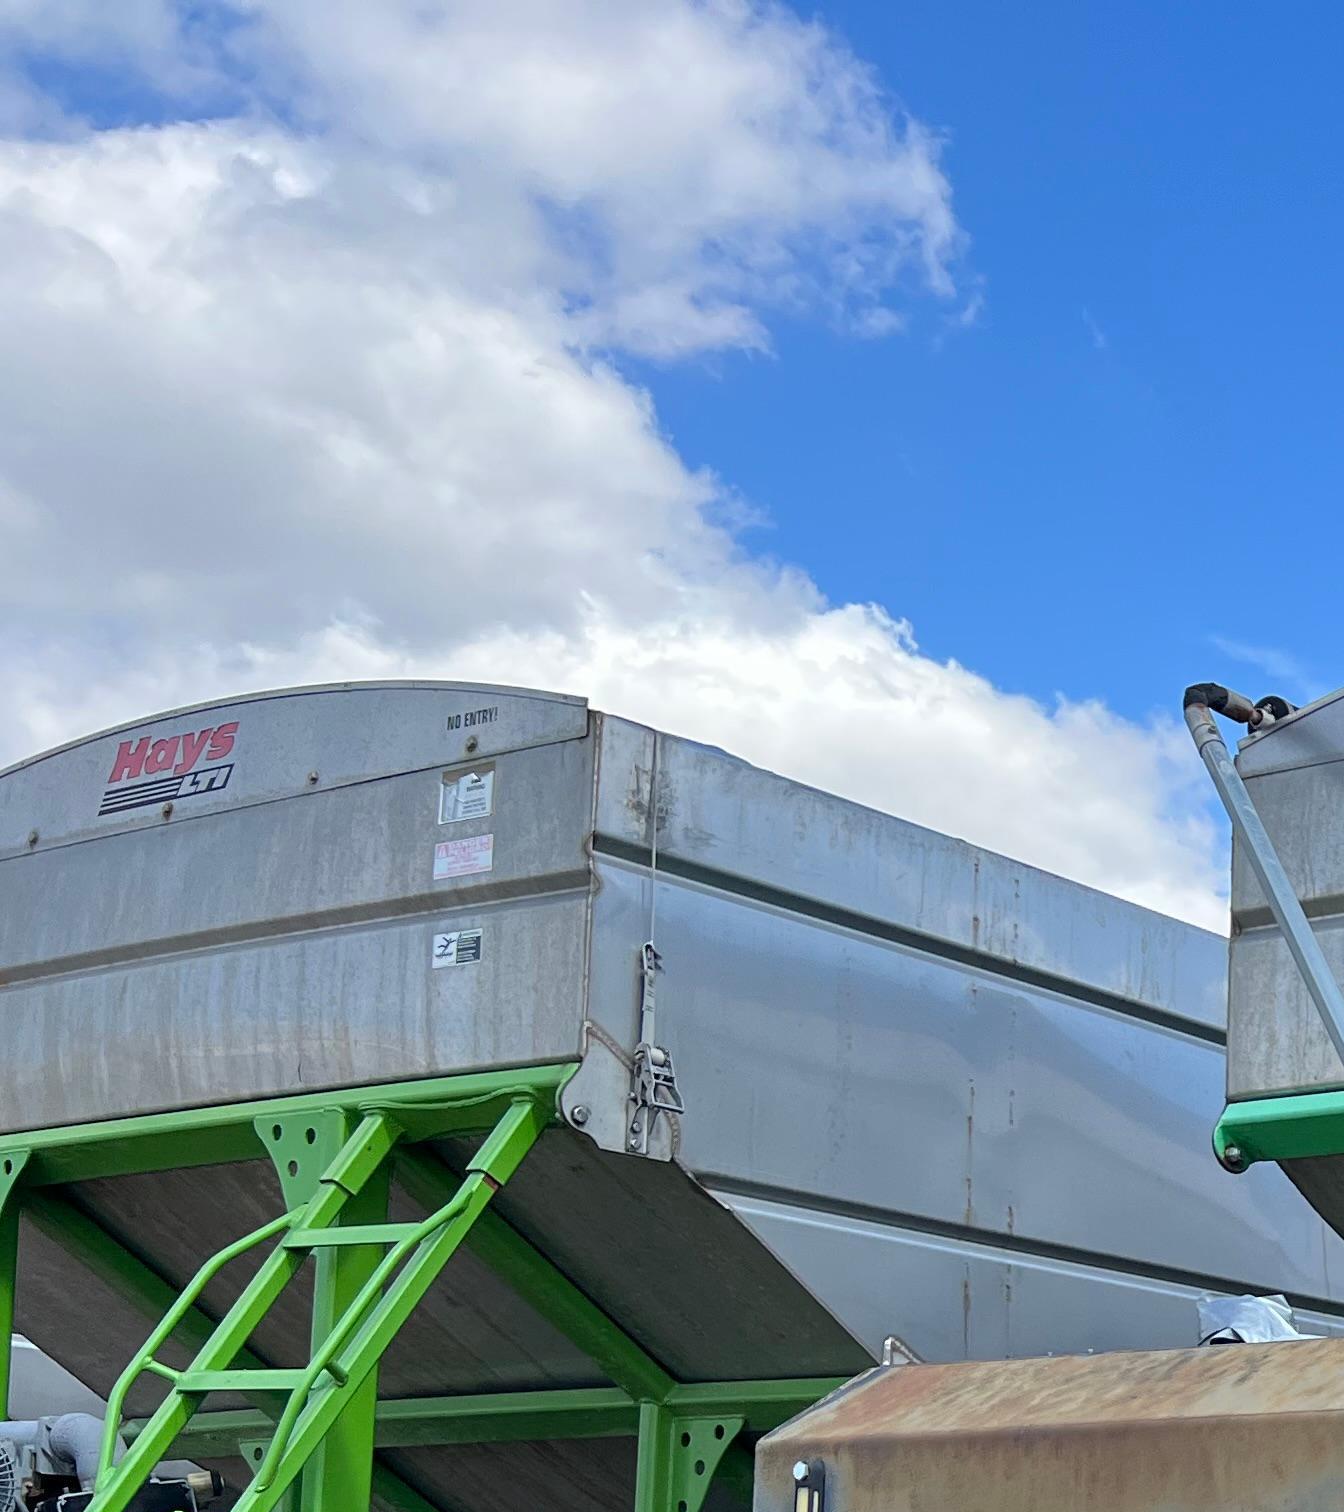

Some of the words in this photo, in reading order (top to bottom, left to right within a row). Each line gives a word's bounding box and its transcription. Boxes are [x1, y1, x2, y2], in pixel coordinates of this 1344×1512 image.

[447, 714, 461, 731] NO
[464, 706, 498, 727] ENTRY!
[108, 721, 240, 784] Hays
[176, 764, 235, 797] LTI
